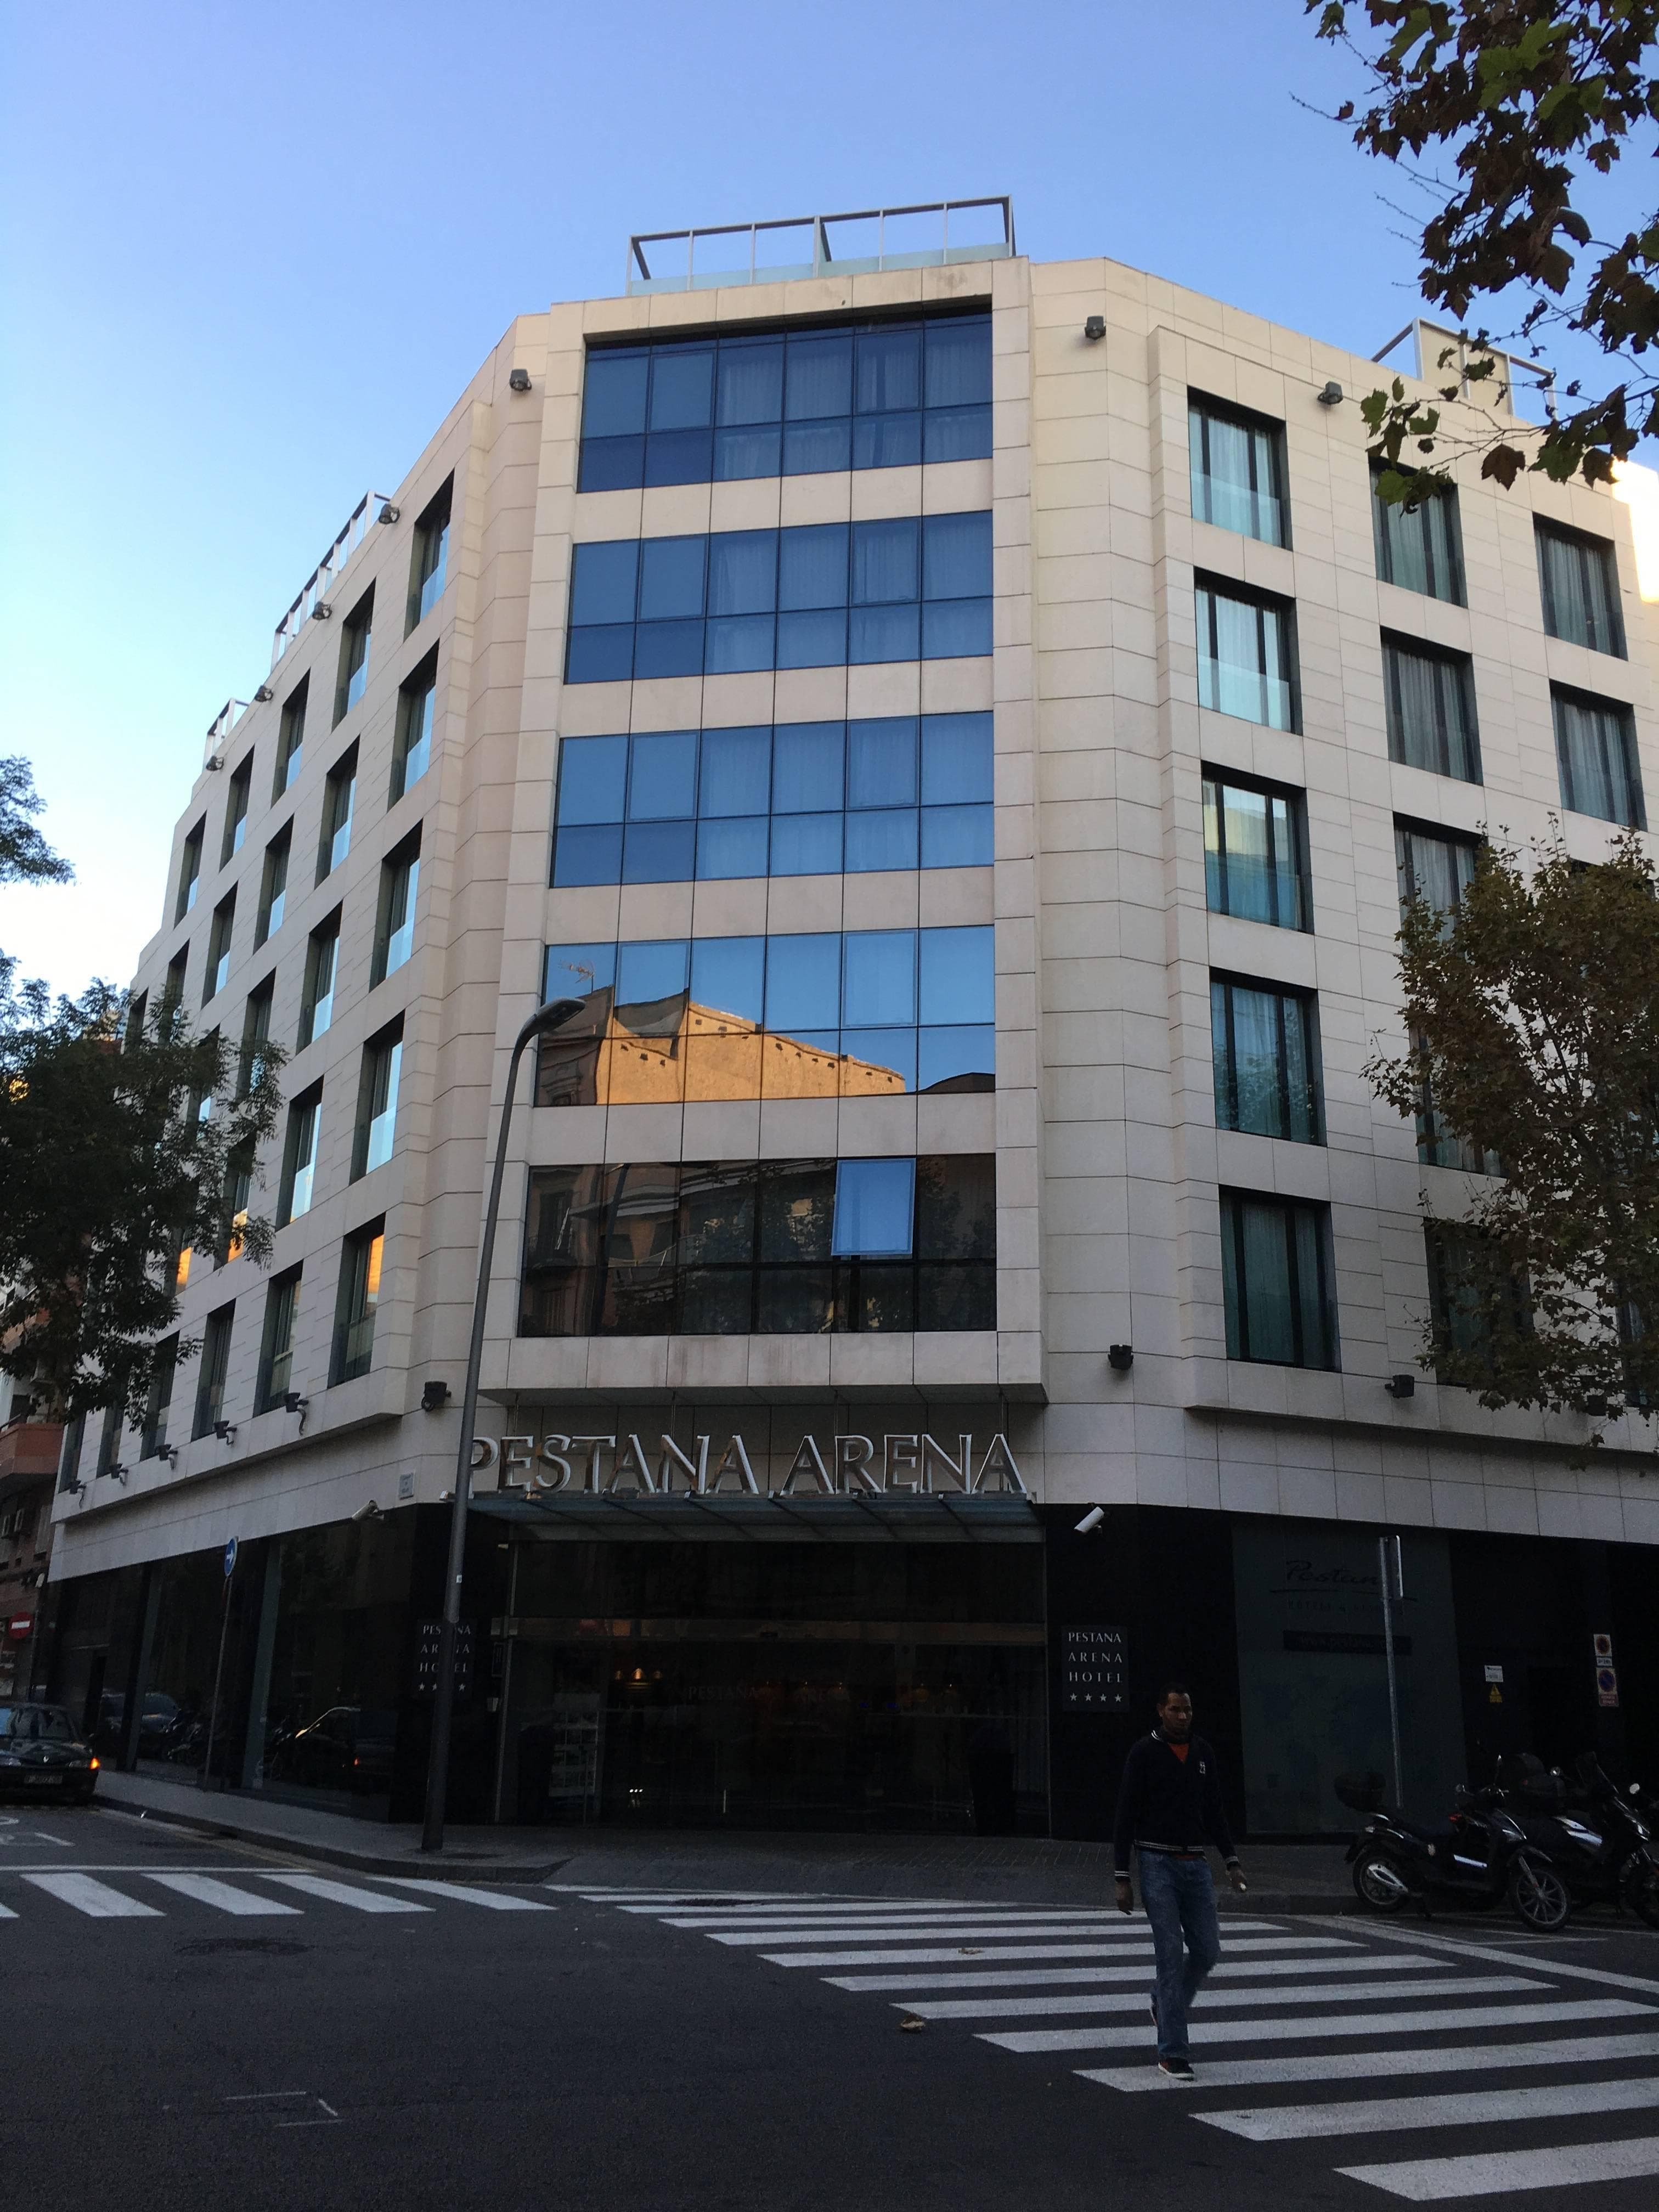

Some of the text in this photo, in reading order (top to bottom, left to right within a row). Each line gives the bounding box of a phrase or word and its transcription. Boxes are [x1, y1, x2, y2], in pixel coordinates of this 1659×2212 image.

[467, 1433, 1028, 1498] PESTANA ARENA
[1285, 1560, 1380, 1585] Pestan
[1068, 1632, 1121, 1643] PESTANA
[1068, 1651, 1123, 1663] ARENA
[419, 1662, 468, 1673] HOEL
[1069, 1672, 1123, 1683] HOTEL
